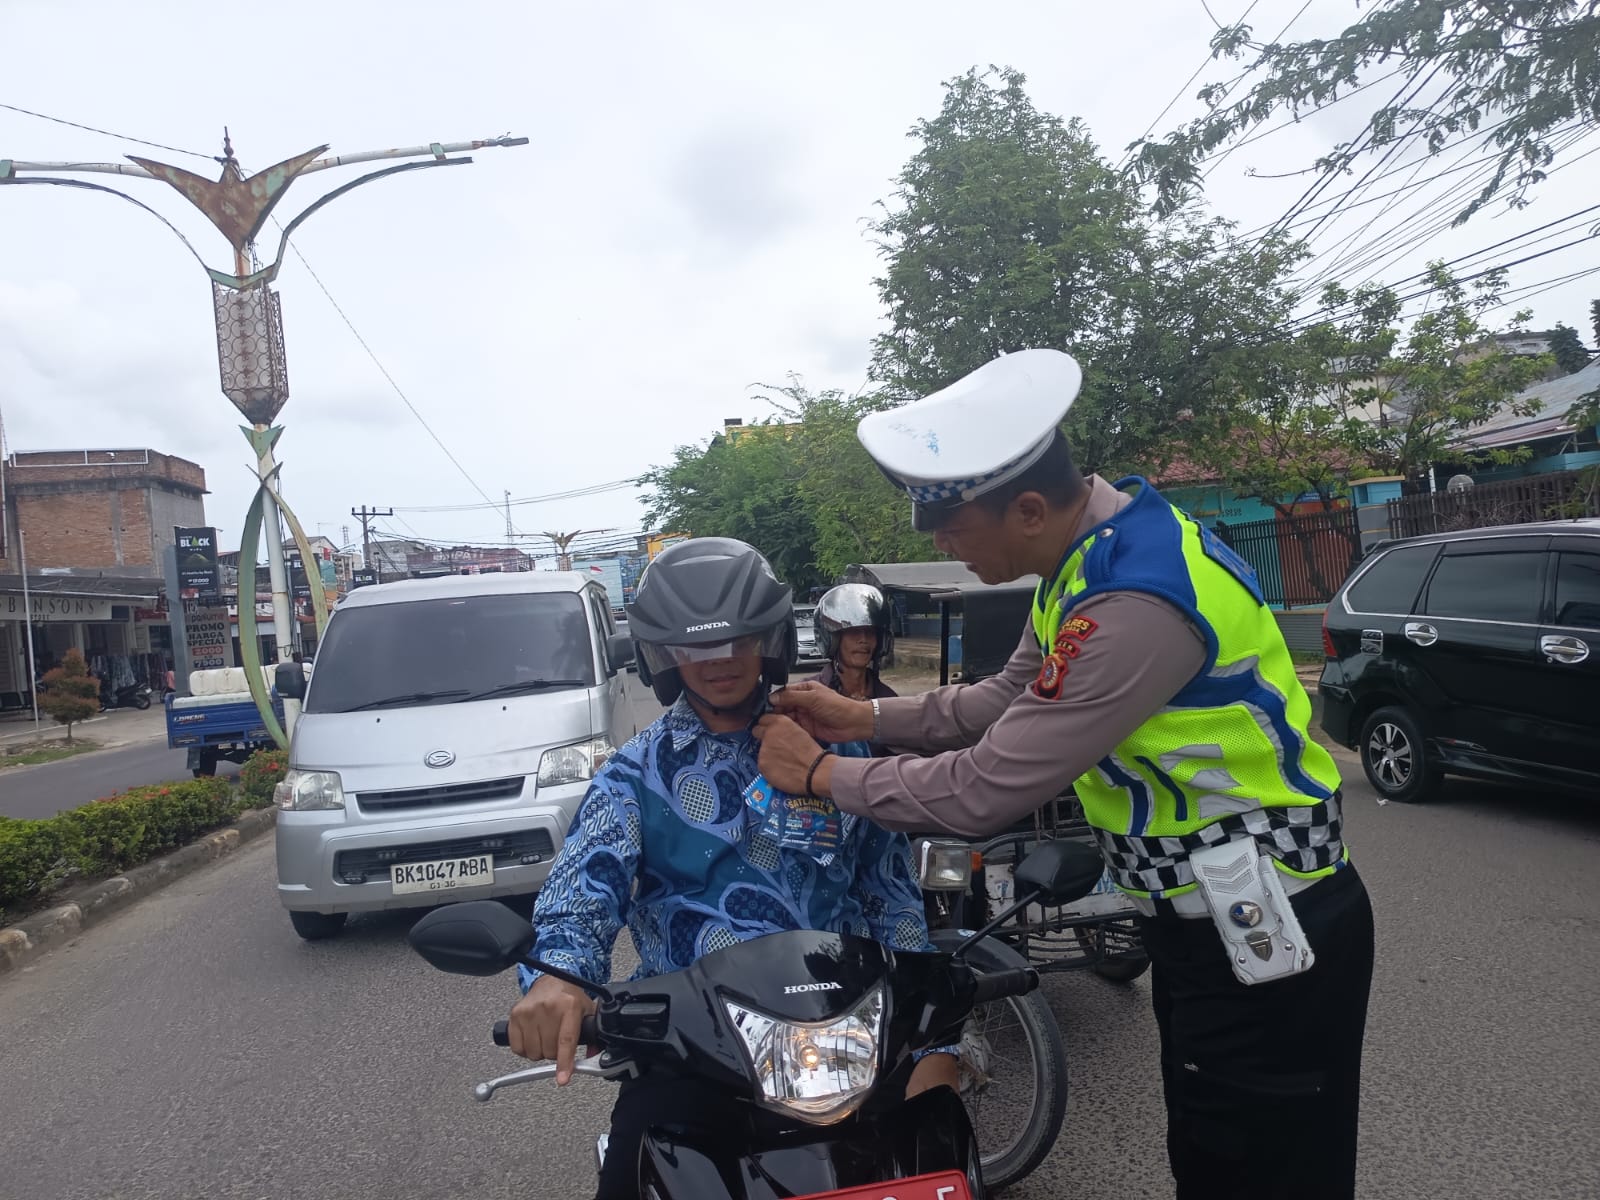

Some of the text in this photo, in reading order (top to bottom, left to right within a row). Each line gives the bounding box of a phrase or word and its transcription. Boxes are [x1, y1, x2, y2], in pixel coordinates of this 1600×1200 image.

[180, 536, 211, 548] BLACK
[186, 623, 224, 632] PROMO
[686, 620, 731, 633] HONDA
[395, 858, 488, 884] BK 1047 ABA
[784, 981, 843, 995] HONDA
